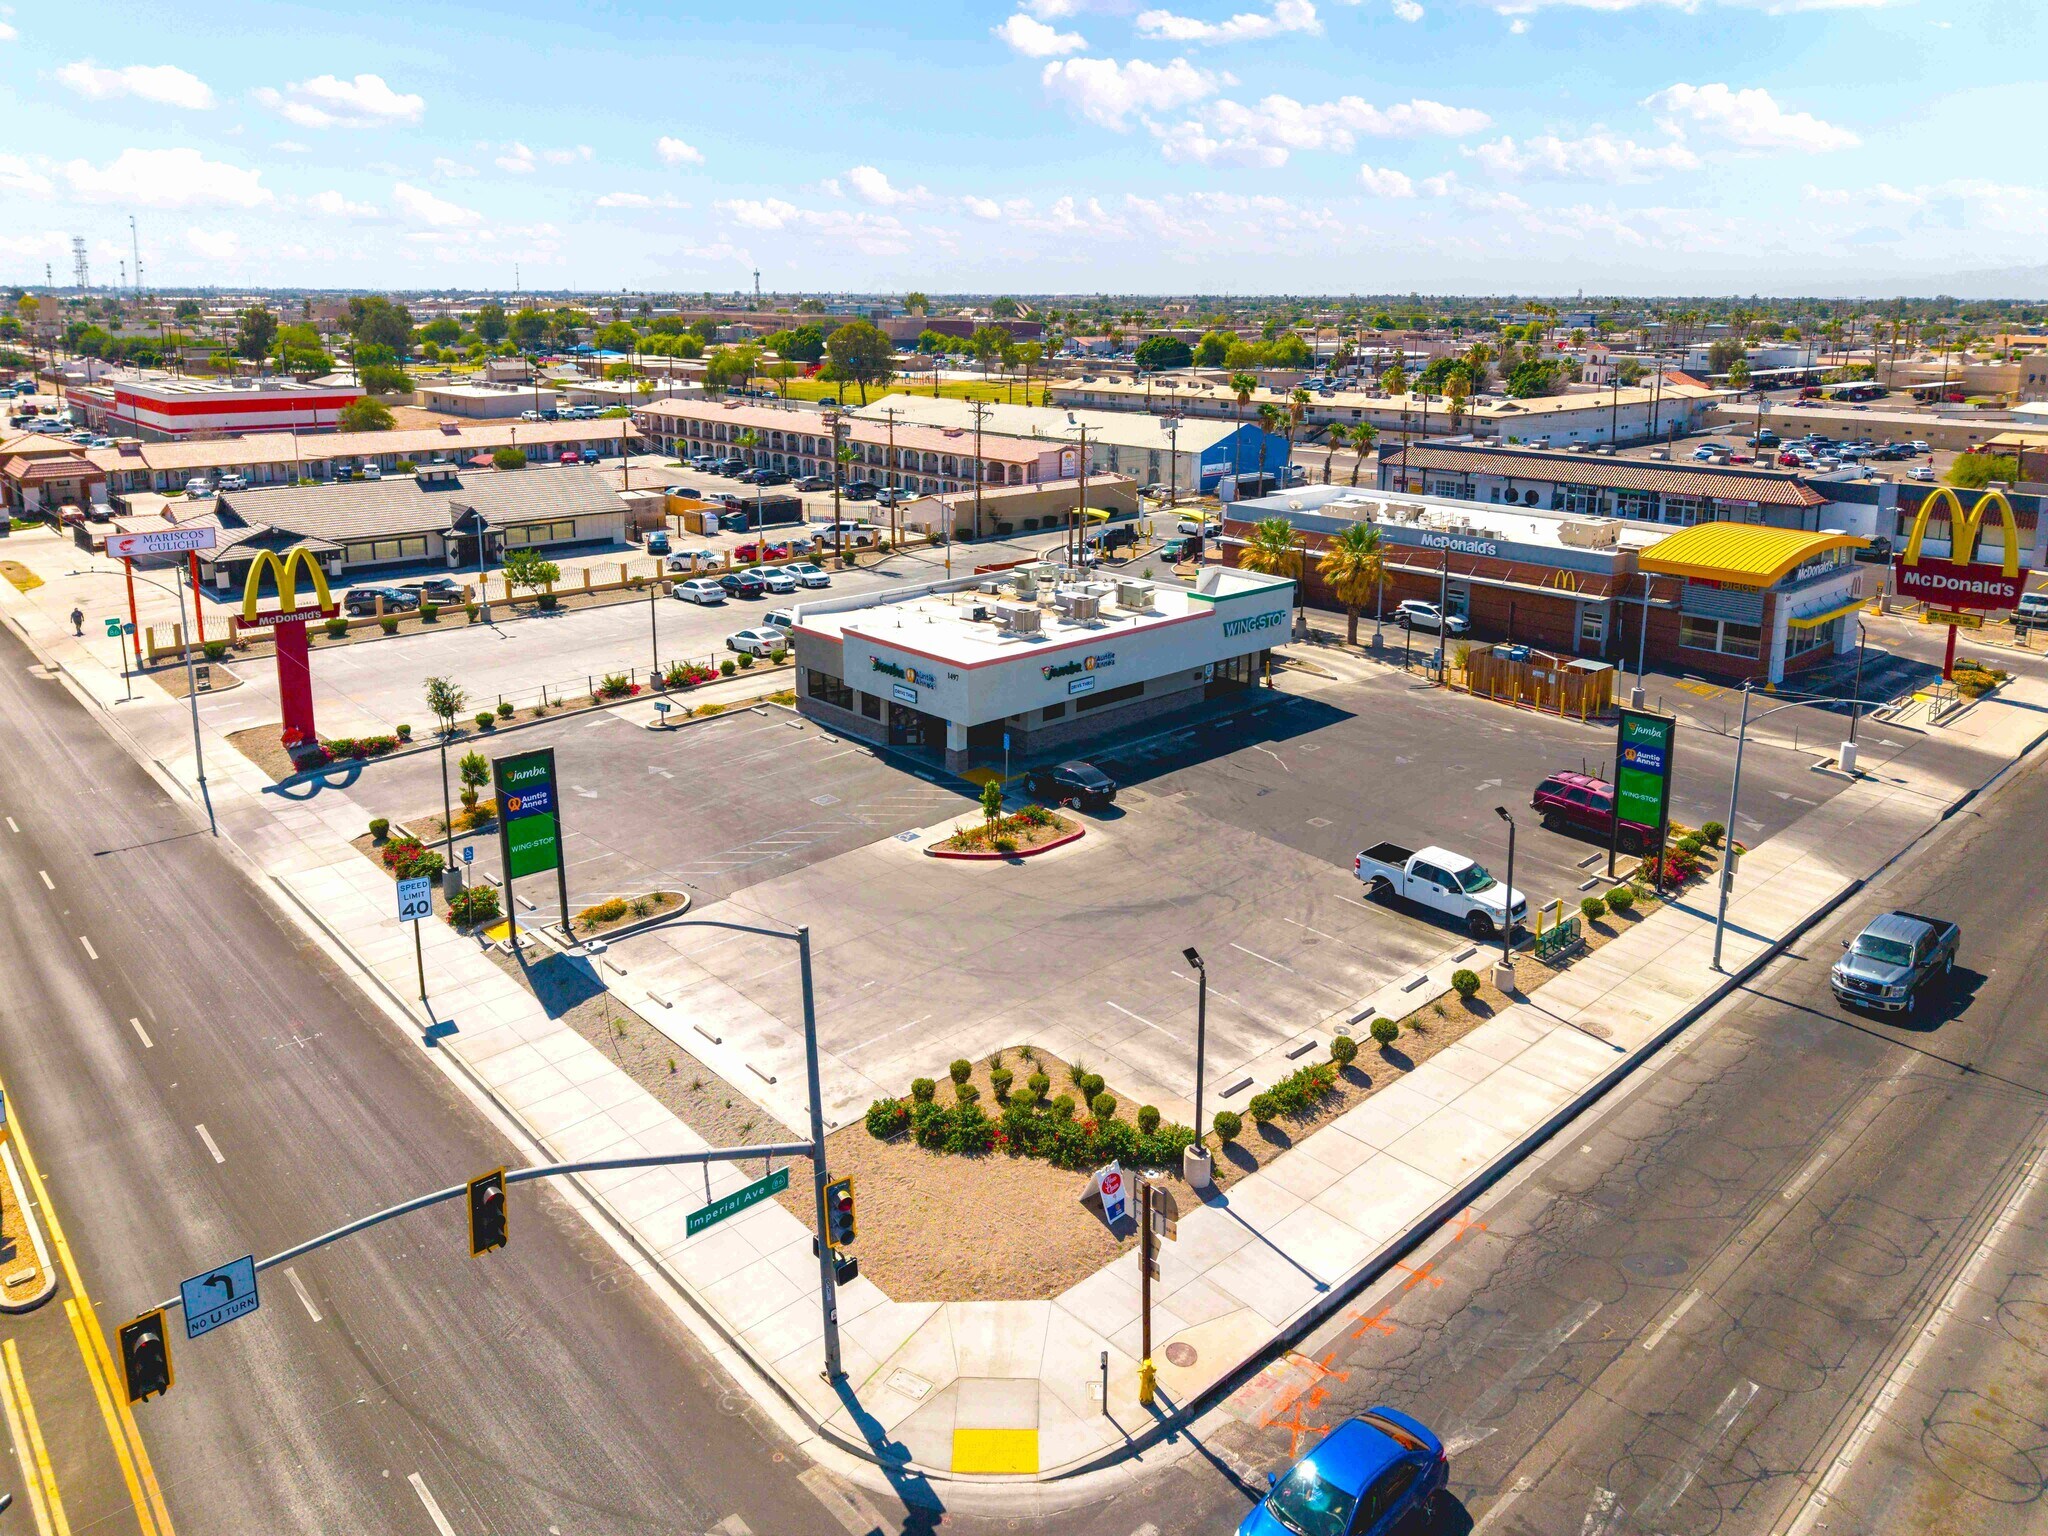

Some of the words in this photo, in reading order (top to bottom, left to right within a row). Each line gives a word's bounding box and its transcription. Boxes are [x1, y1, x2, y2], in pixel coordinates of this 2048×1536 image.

[143, 530, 204, 544] MARISCOS
[1421, 533, 1496, 556] McDonald's
[148, 540, 199, 552] CULICHI
[1797, 560, 1834, 581] McDonald's
[1903, 571, 2015, 597] McDonald's
[259, 610, 322, 626] McDonald's
[1632, 723, 1662, 738] jamba
[1636, 757, 1660, 768] Anne's
[1637, 751, 1660, 762] Auntie
[511, 766, 546, 782] jamba
[521, 791, 547, 803] Auntie
[400, 881, 428, 892] SPEED
[403, 891, 425, 901] LIMIT
[402, 900, 429, 916] 40
[689, 1198, 739, 1229] Imperial
[744, 1187, 765, 1202] Ave
[192, 1319, 207, 1331] NO
[210, 1311, 222, 1323] U
[225, 1297, 255, 1316] TURN
